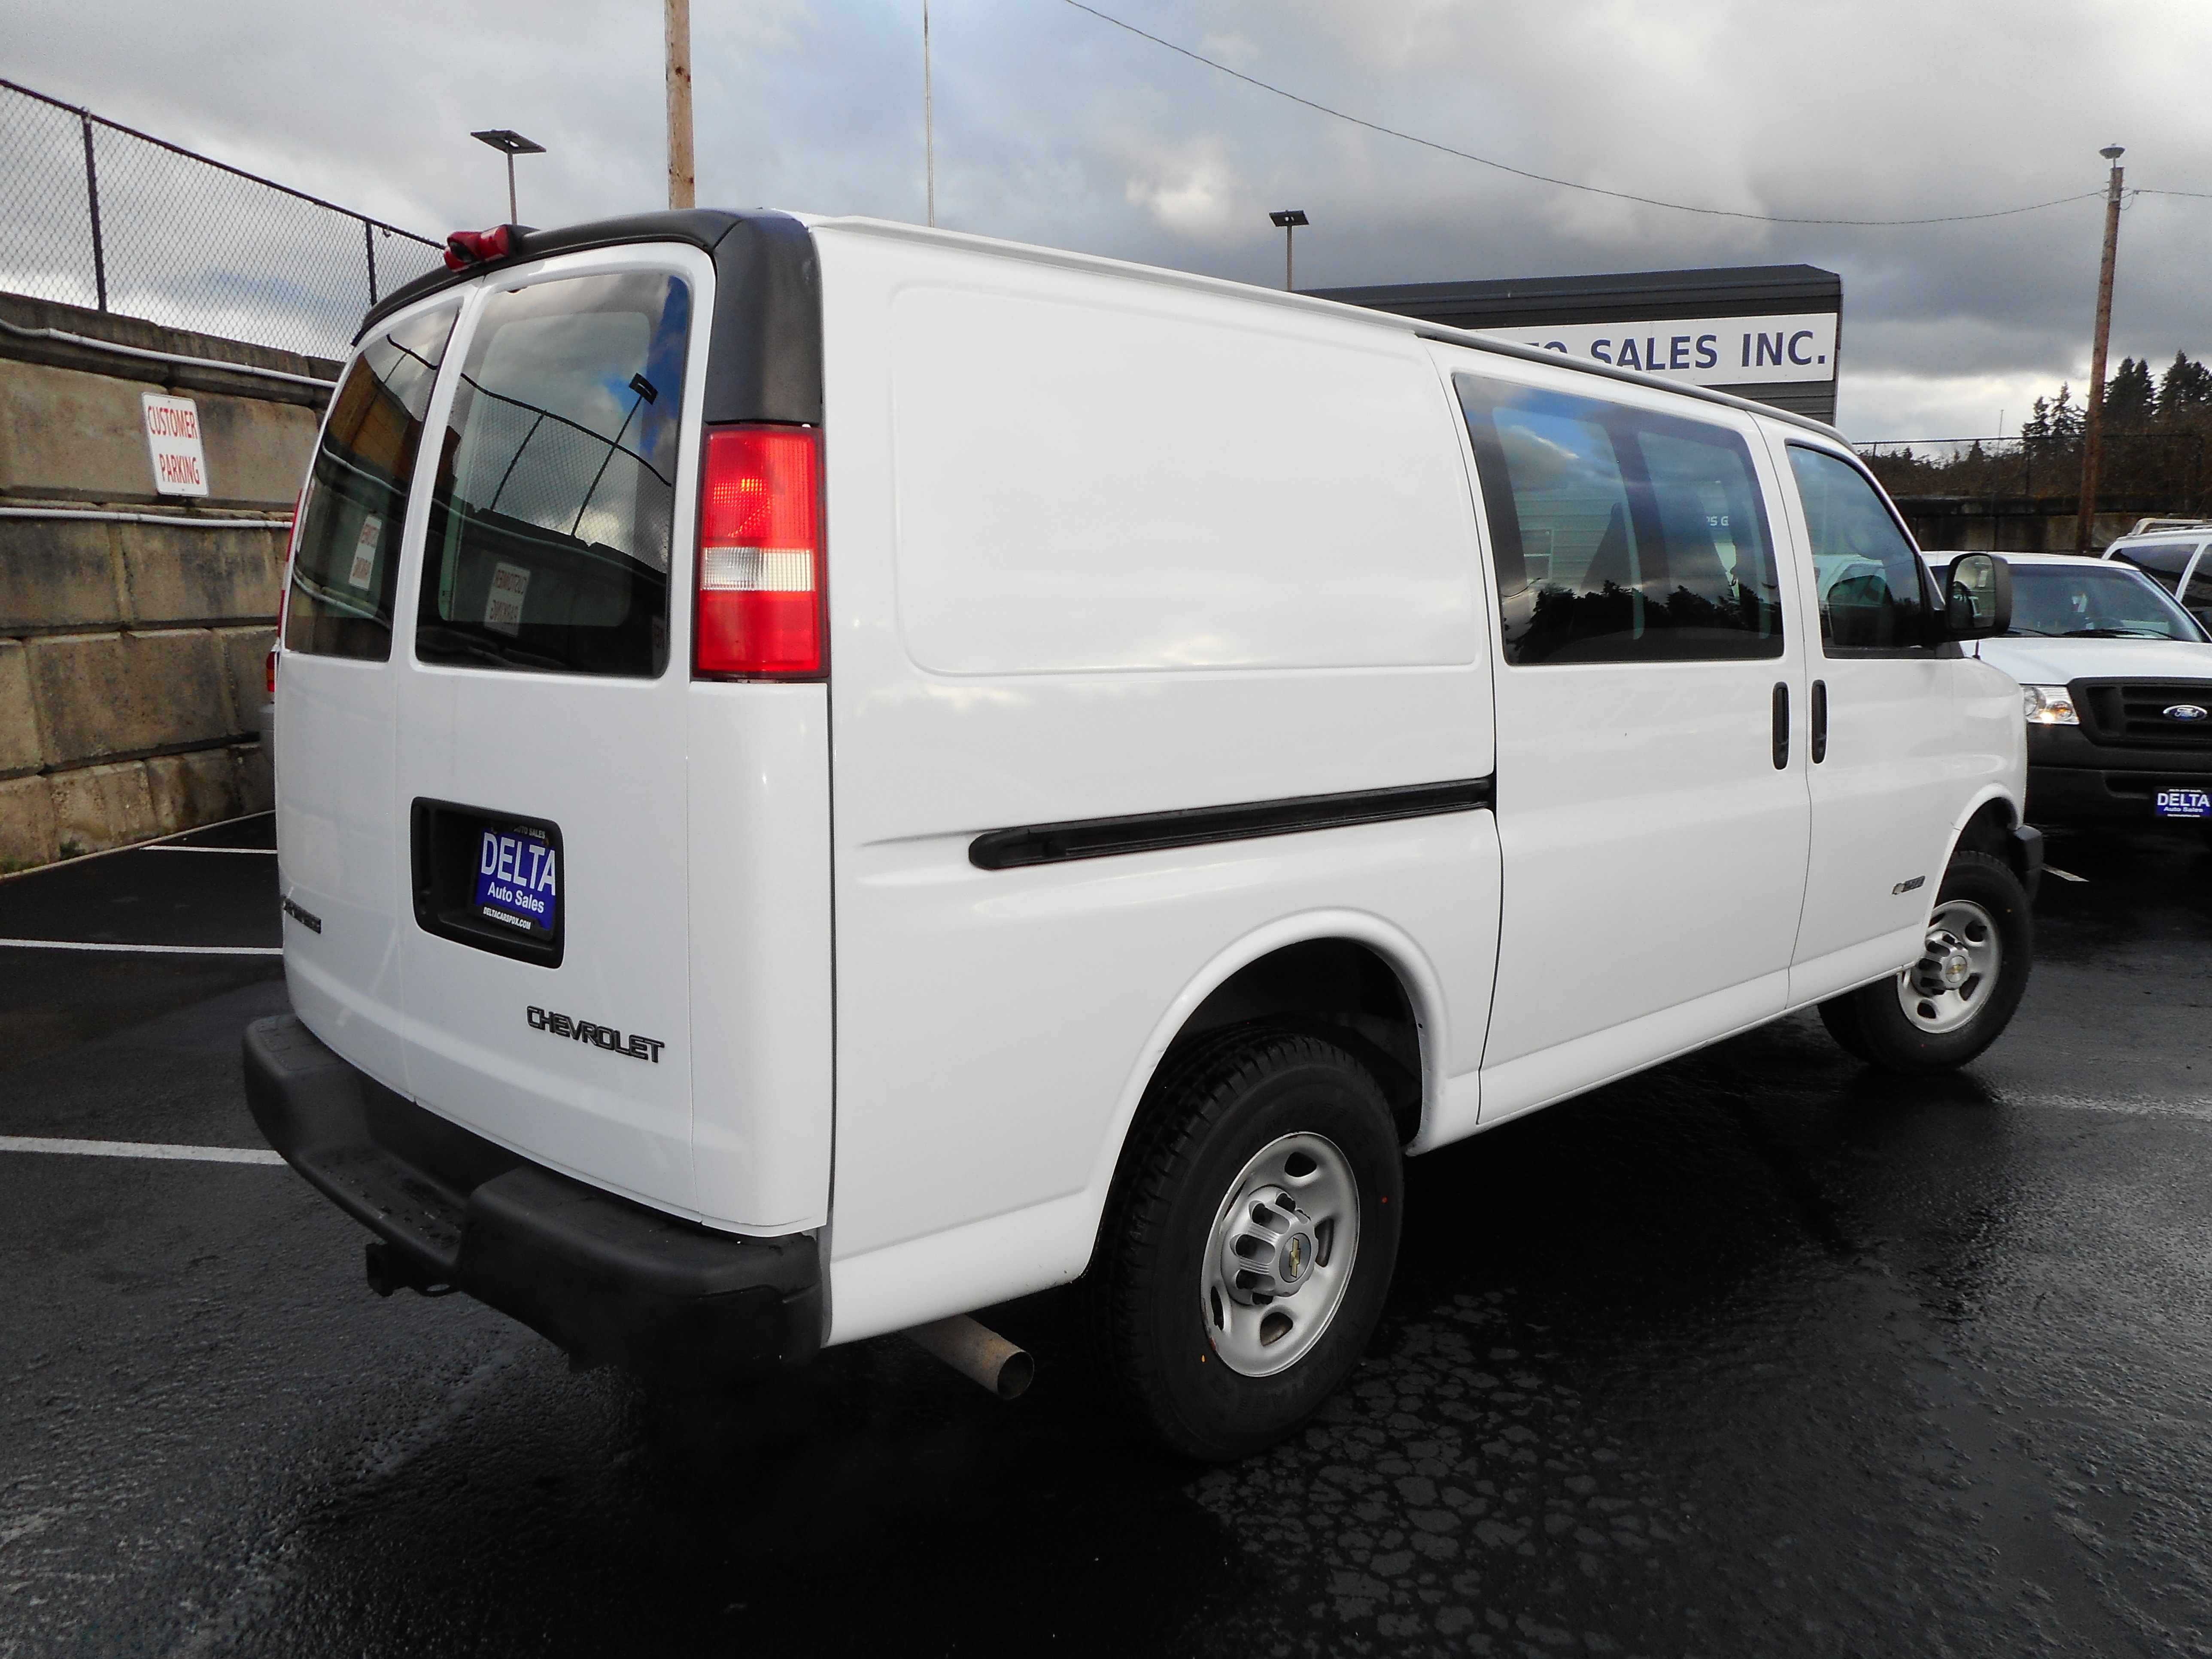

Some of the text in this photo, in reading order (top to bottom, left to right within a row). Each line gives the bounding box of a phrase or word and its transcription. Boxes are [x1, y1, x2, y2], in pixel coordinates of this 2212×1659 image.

[1590, 330, 1826, 371] SALES INC.
[148, 406, 198, 439] CUSTOMER
[159, 453, 200, 485] PARKING
[2175, 708, 2198, 717] Ford
[2157, 793, 2210, 807] DELTA
[529, 828, 545, 839] SALES
[481, 832, 556, 896] DELTA
[487, 881, 544, 913] Auto Sales
[527, 1005, 665, 1063] CHEVROLET
